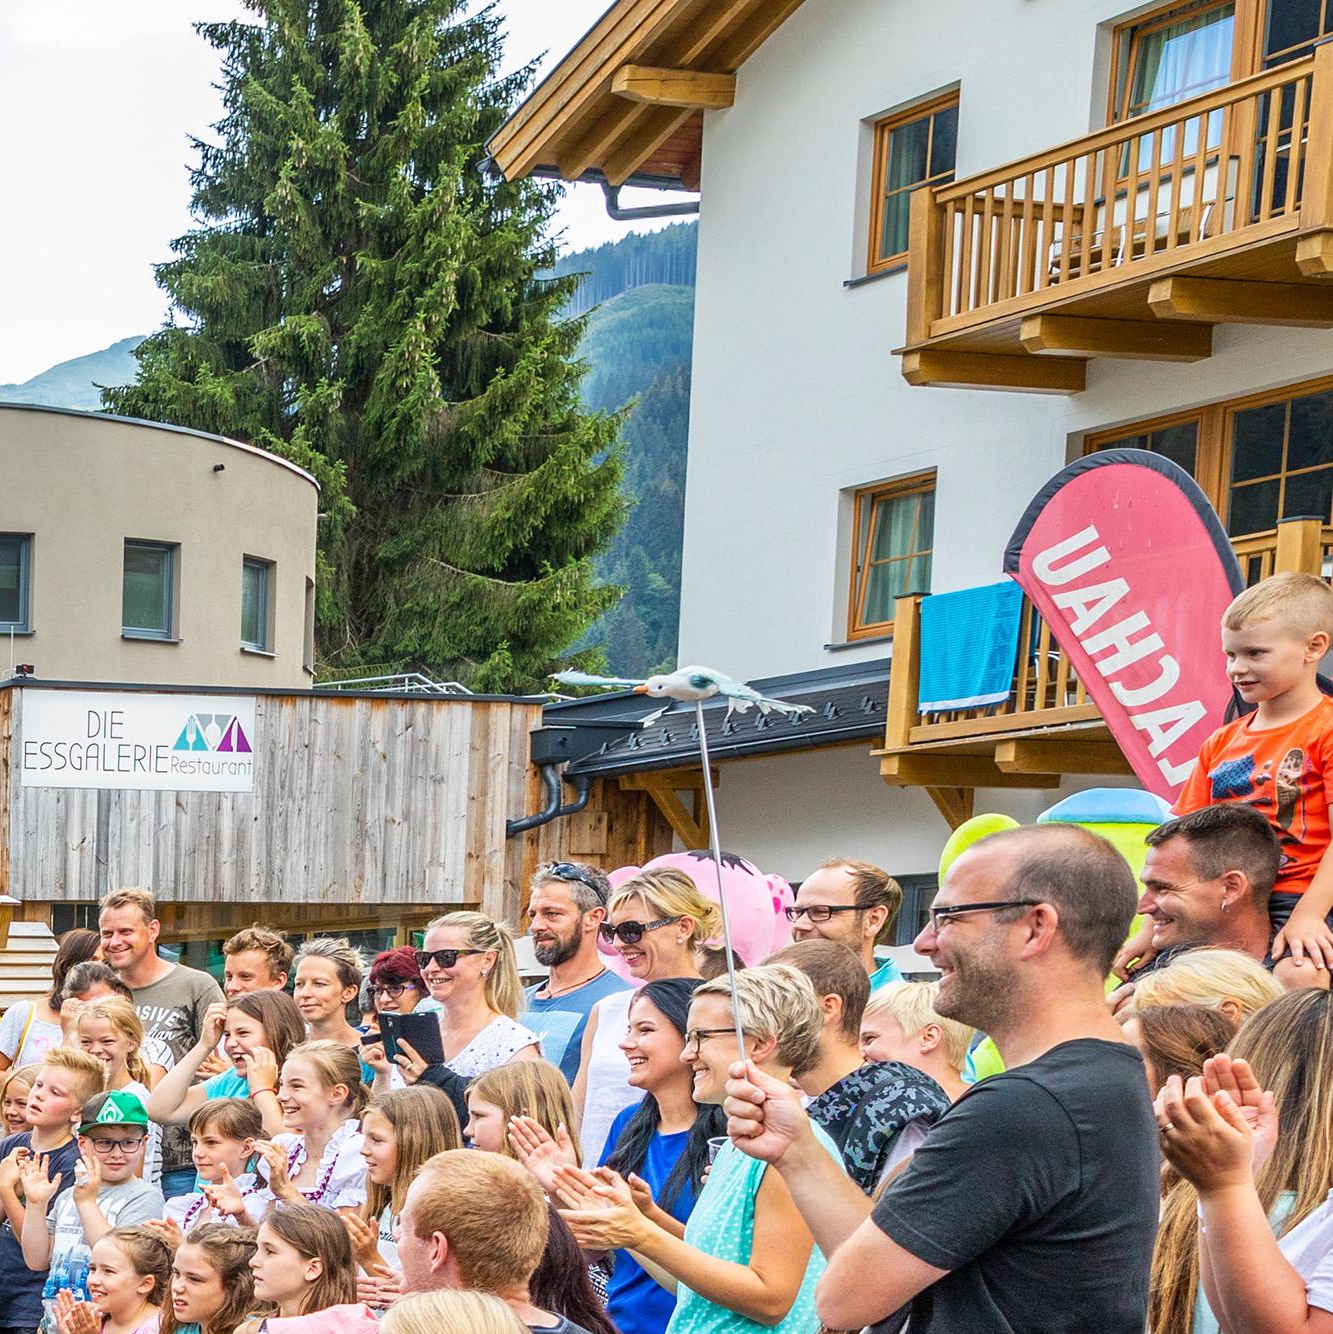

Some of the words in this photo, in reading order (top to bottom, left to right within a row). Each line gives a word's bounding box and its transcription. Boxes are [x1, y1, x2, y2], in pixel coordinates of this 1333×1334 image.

[87, 710, 124, 739] DIE
[24, 741, 169, 773] ESSGALERIE
[171, 756, 252, 775] Restaurant
